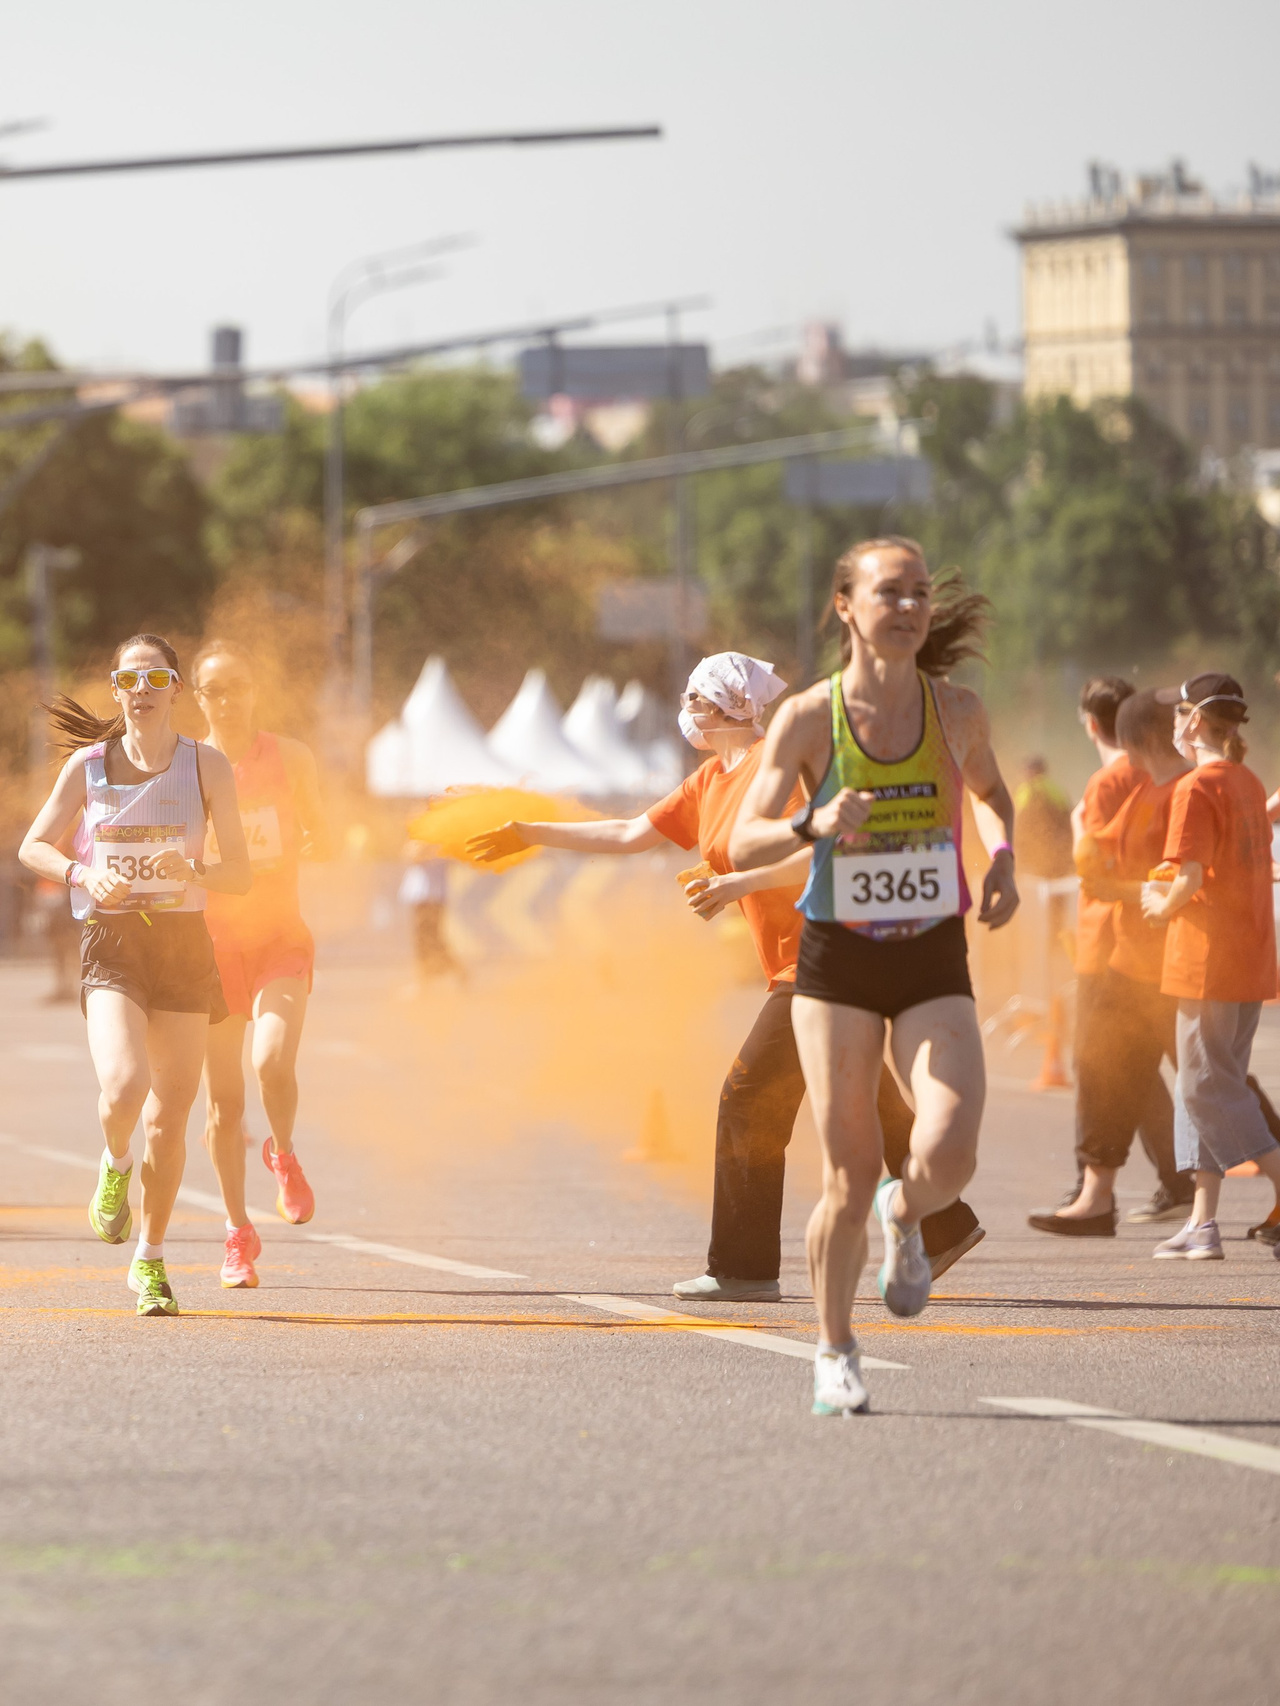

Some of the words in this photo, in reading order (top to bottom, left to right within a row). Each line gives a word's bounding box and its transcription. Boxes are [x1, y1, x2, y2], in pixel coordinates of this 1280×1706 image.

[872, 784, 934, 799] AWLIFE
[867, 811, 899, 823] PORT
[902, 809, 935, 822] TEAM
[851, 868, 940, 905] 3365
